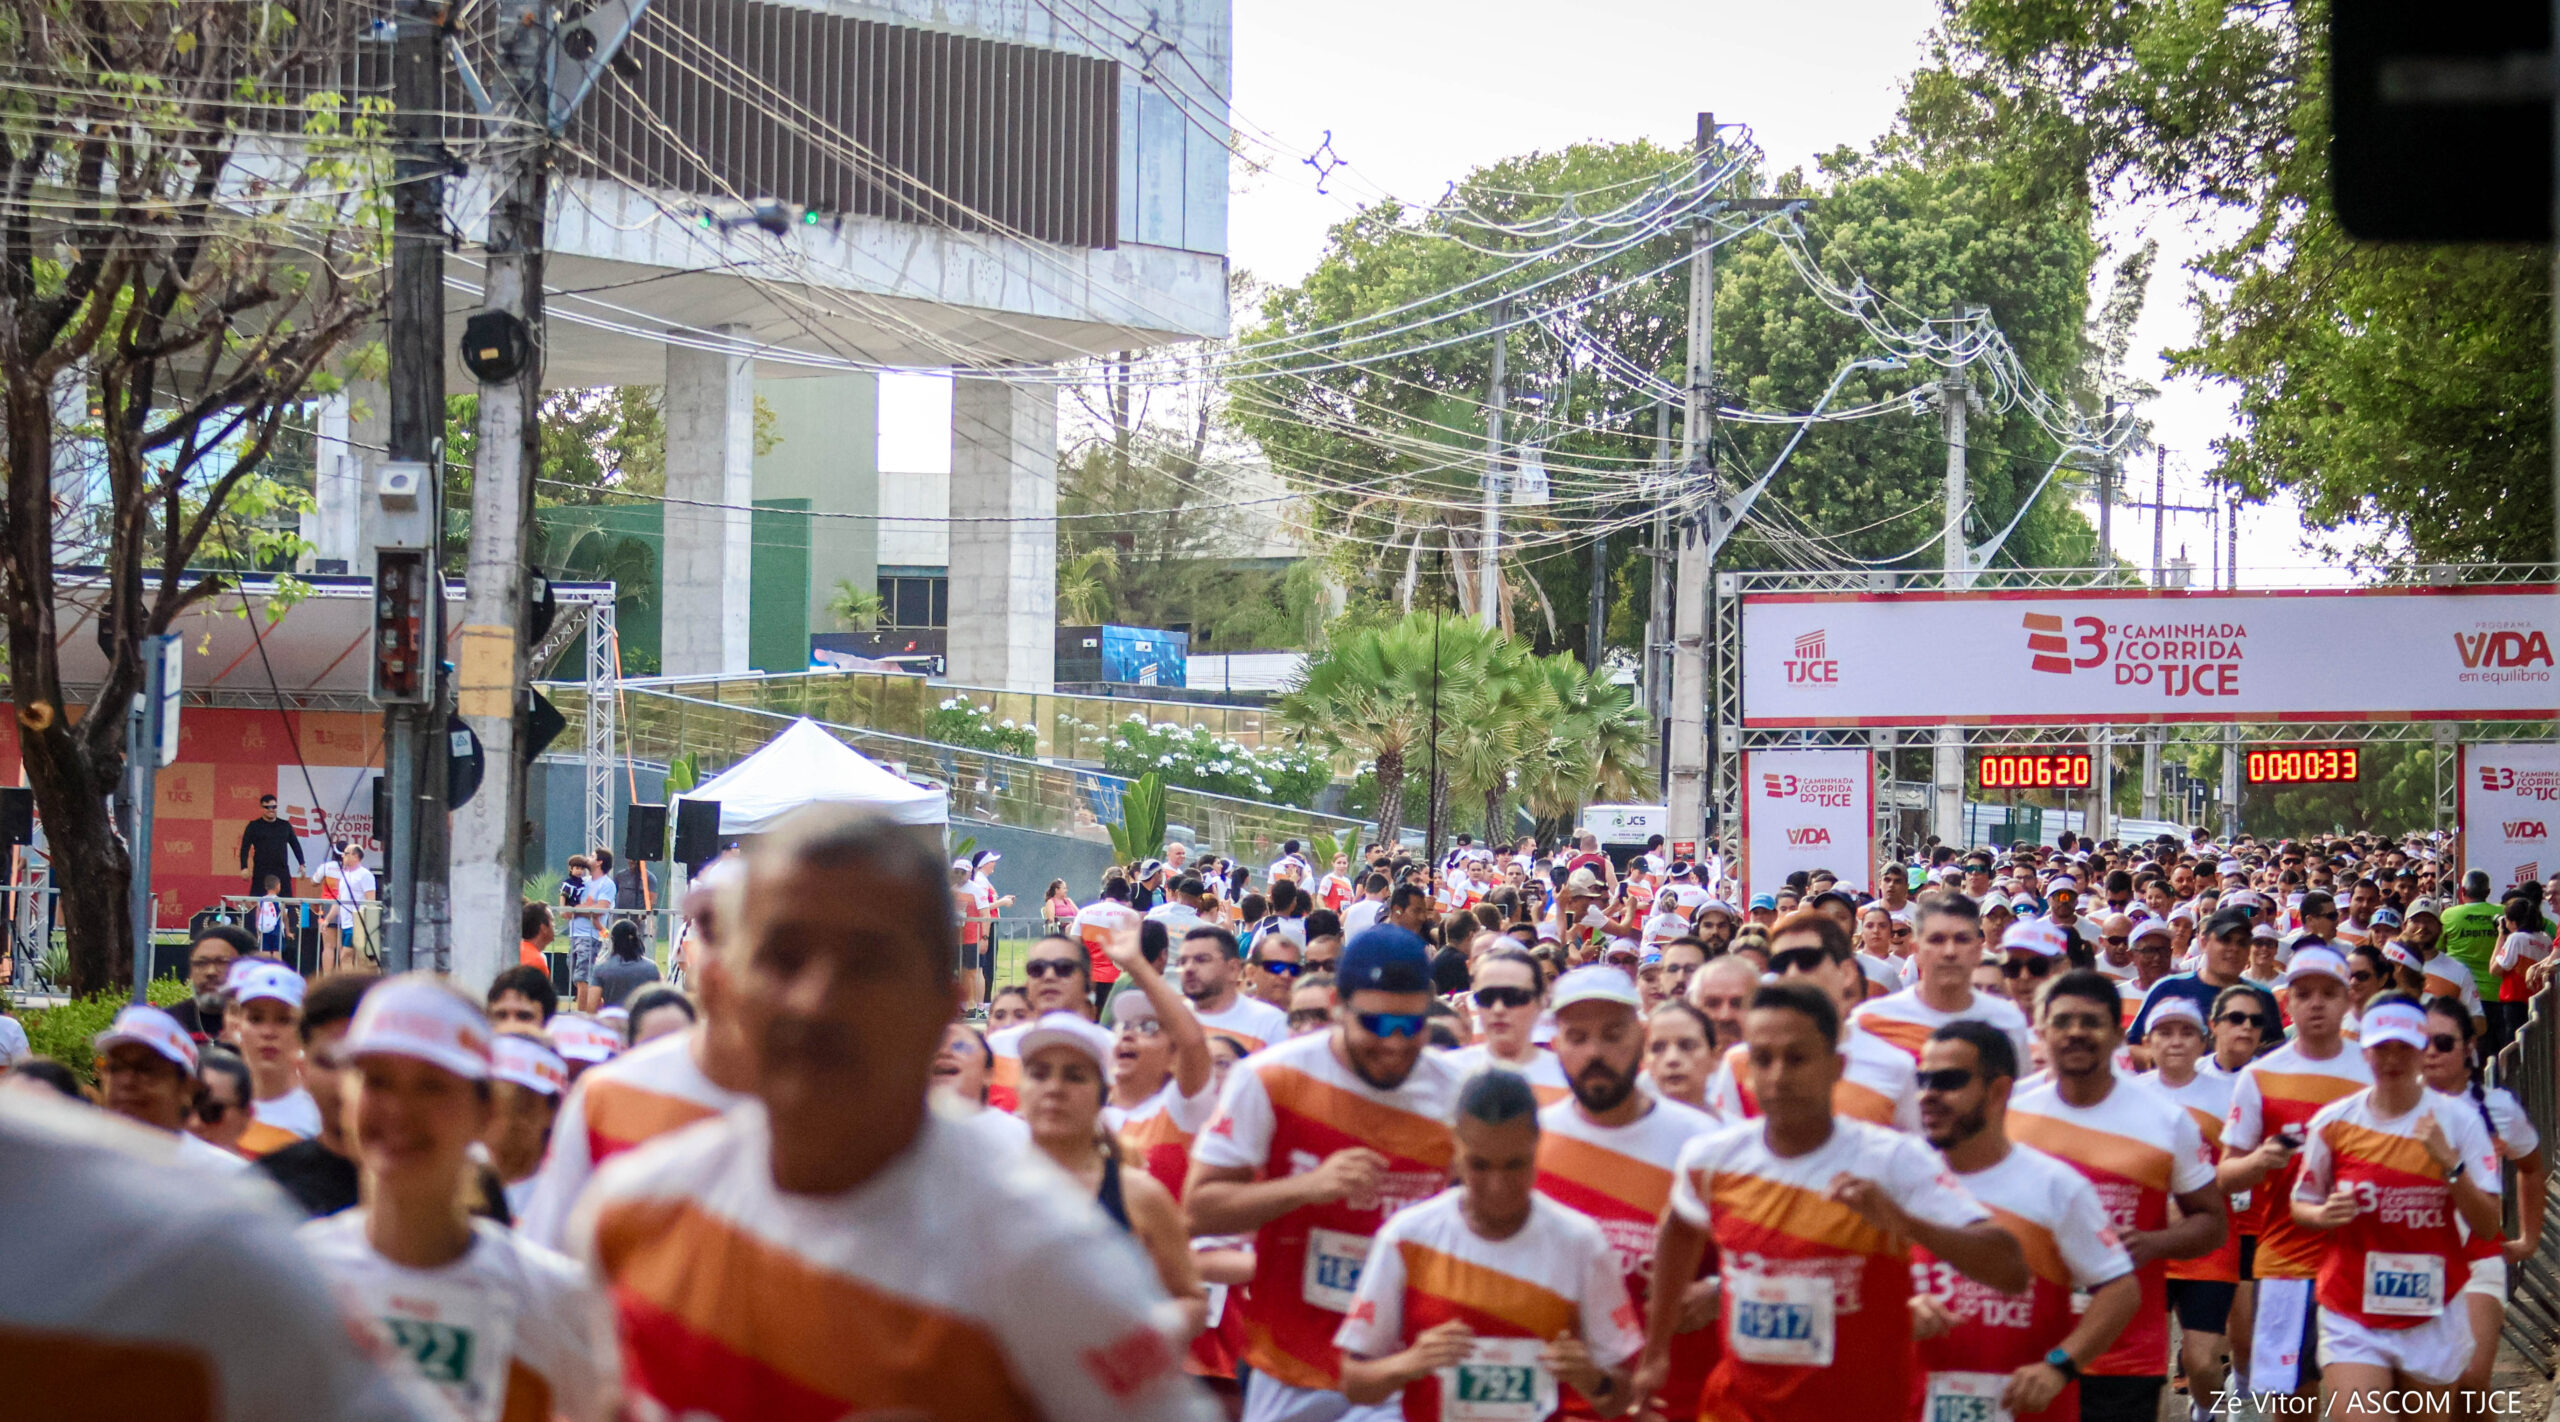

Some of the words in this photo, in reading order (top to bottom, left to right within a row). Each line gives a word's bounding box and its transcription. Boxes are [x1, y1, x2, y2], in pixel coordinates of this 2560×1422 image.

[2123, 624, 2247, 639] CAMINHADA
[2475, 621, 2532, 629] PROGRAMA
[2115, 640, 2243, 661] /CORRIDA
[2453, 630, 2555, 669] VIDA
[1783, 660, 1838, 683] TJCE
[2459, 672, 2479, 682] em
[2115, 663, 2154, 685] DO
[2158, 664, 2239, 696] TJCE
[1981, 757, 2090, 785] 000620
[2249, 751, 2357, 781] 00:00:33
[1800, 784, 1853, 793] /CORRIDA
[2516, 786, 2533, 796] DO
[2535, 787, 2560, 800] TJC
[168, 790, 193, 803] TJCE
[1800, 793, 1816, 803] DO
[1818, 793, 1852, 807] TJCE
[334, 813, 373, 821] CAMINH
[1627, 816, 1646, 825] JCS
[330, 821, 372, 832] /CORR
[2502, 821, 2547, 838] VIDA
[1786, 828, 1831, 845] VIDA
[2377, 1274, 2430, 1297] 1718
